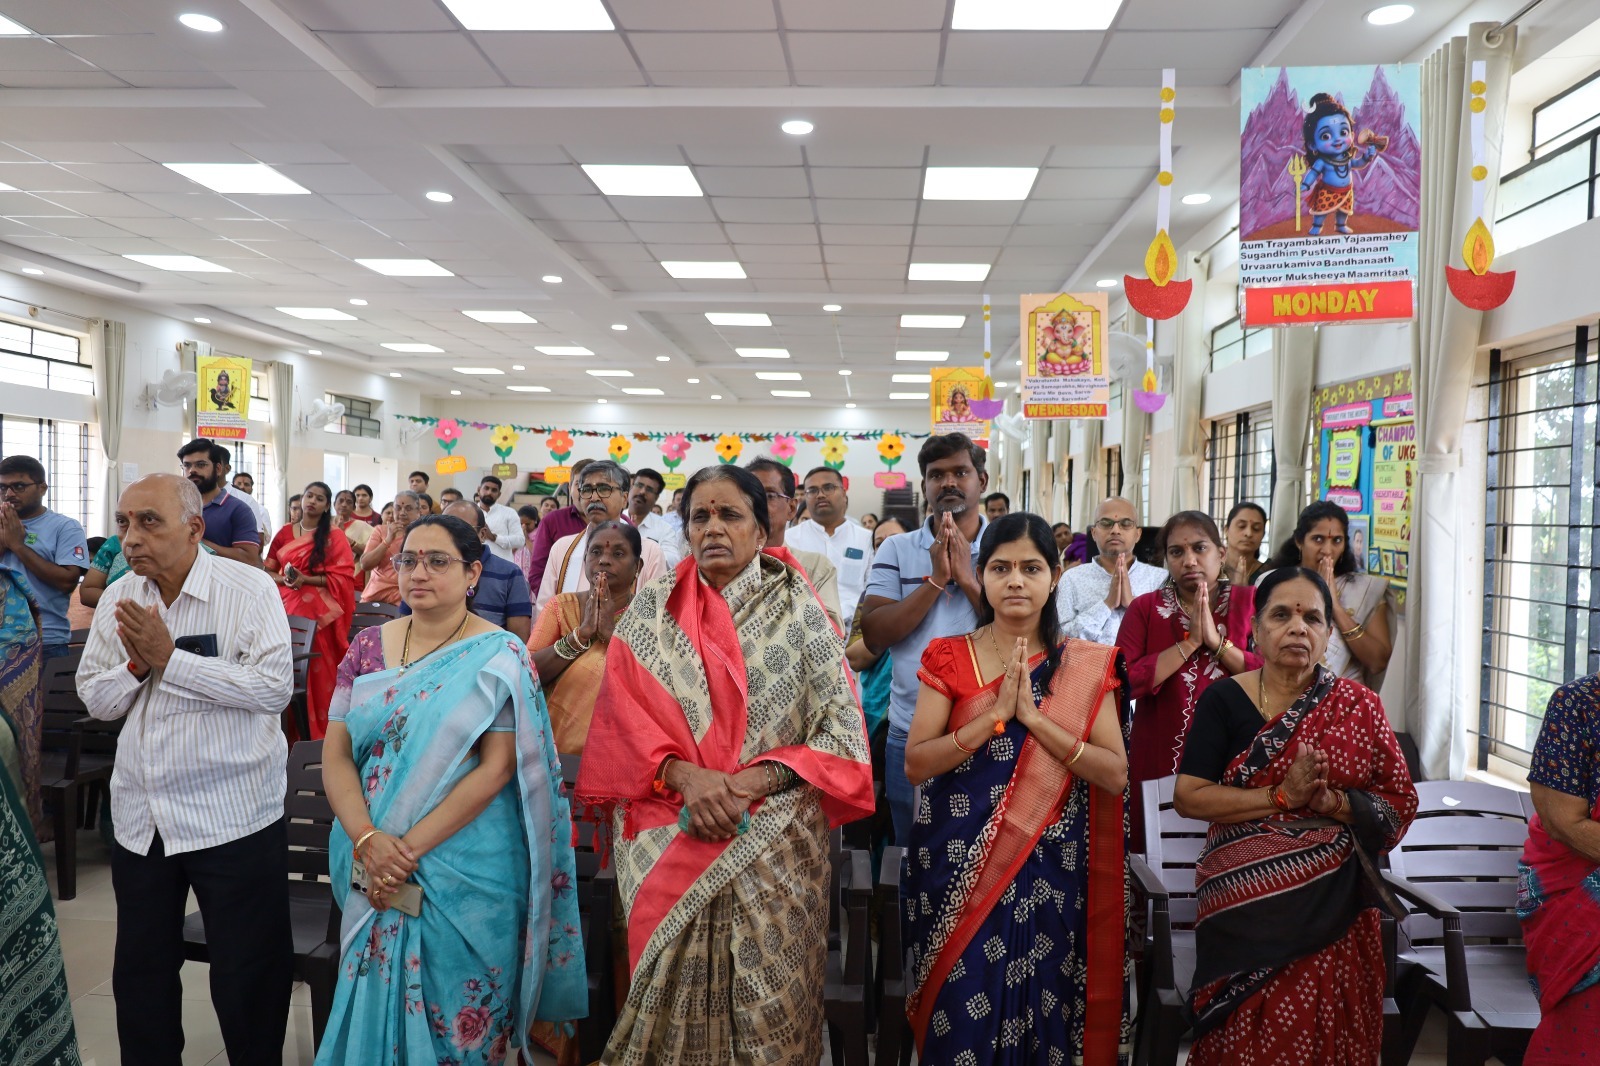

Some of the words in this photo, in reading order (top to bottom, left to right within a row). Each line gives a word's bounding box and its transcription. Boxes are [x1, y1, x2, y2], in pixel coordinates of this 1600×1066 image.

[1240, 242, 1264, 250] Aum
[1266, 237, 1340, 249] Trayambakam
[1343, 233, 1408, 244] Yajaamahey
[1240, 250, 1298, 260] Sugandhim
[1324, 256, 1394, 267] Bandhanaath
[1285, 271, 1345, 281] Muksheeya
[1347, 268, 1409, 279] Maamritaat
[1272, 288, 1378, 317] MONDAY
[1026, 404, 1104, 417] WEDNESDAY
[201, 427, 242, 437] SATURDAY
[1377, 424, 1417, 443] CHAMPIO
[1383, 445, 1393, 461] OF
[1398, 445, 1416, 461] UKG
